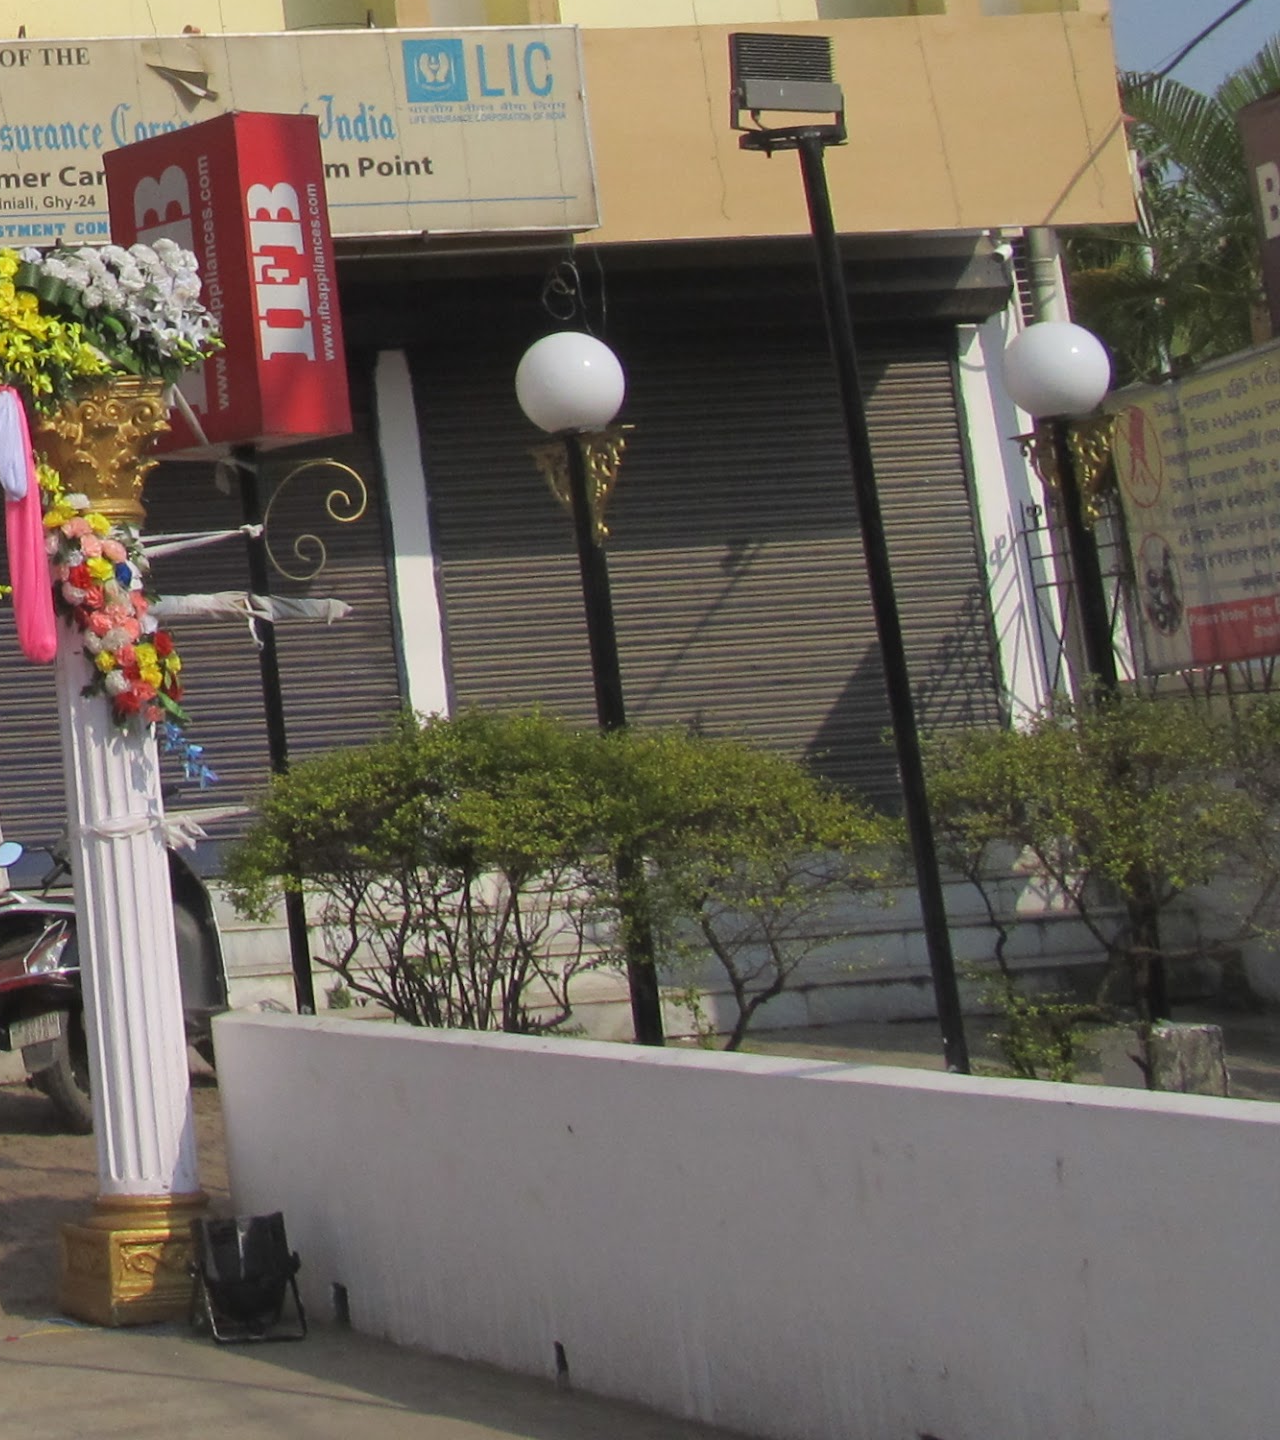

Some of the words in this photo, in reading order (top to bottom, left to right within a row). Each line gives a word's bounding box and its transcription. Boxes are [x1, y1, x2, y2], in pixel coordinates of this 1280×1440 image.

[39, 46, 91, 67] THE
[475, 40, 554, 98] LIC
[319, 94, 397, 143] India
[58, 165, 108, 189] Car
[358, 155, 434, 179] Point
[43, 193, 96, 213] Ghy-24
[74, 220, 108, 236] CON
[246, 181, 316, 362] IFB
[306, 182, 335, 362] www.ifbappliances.com
